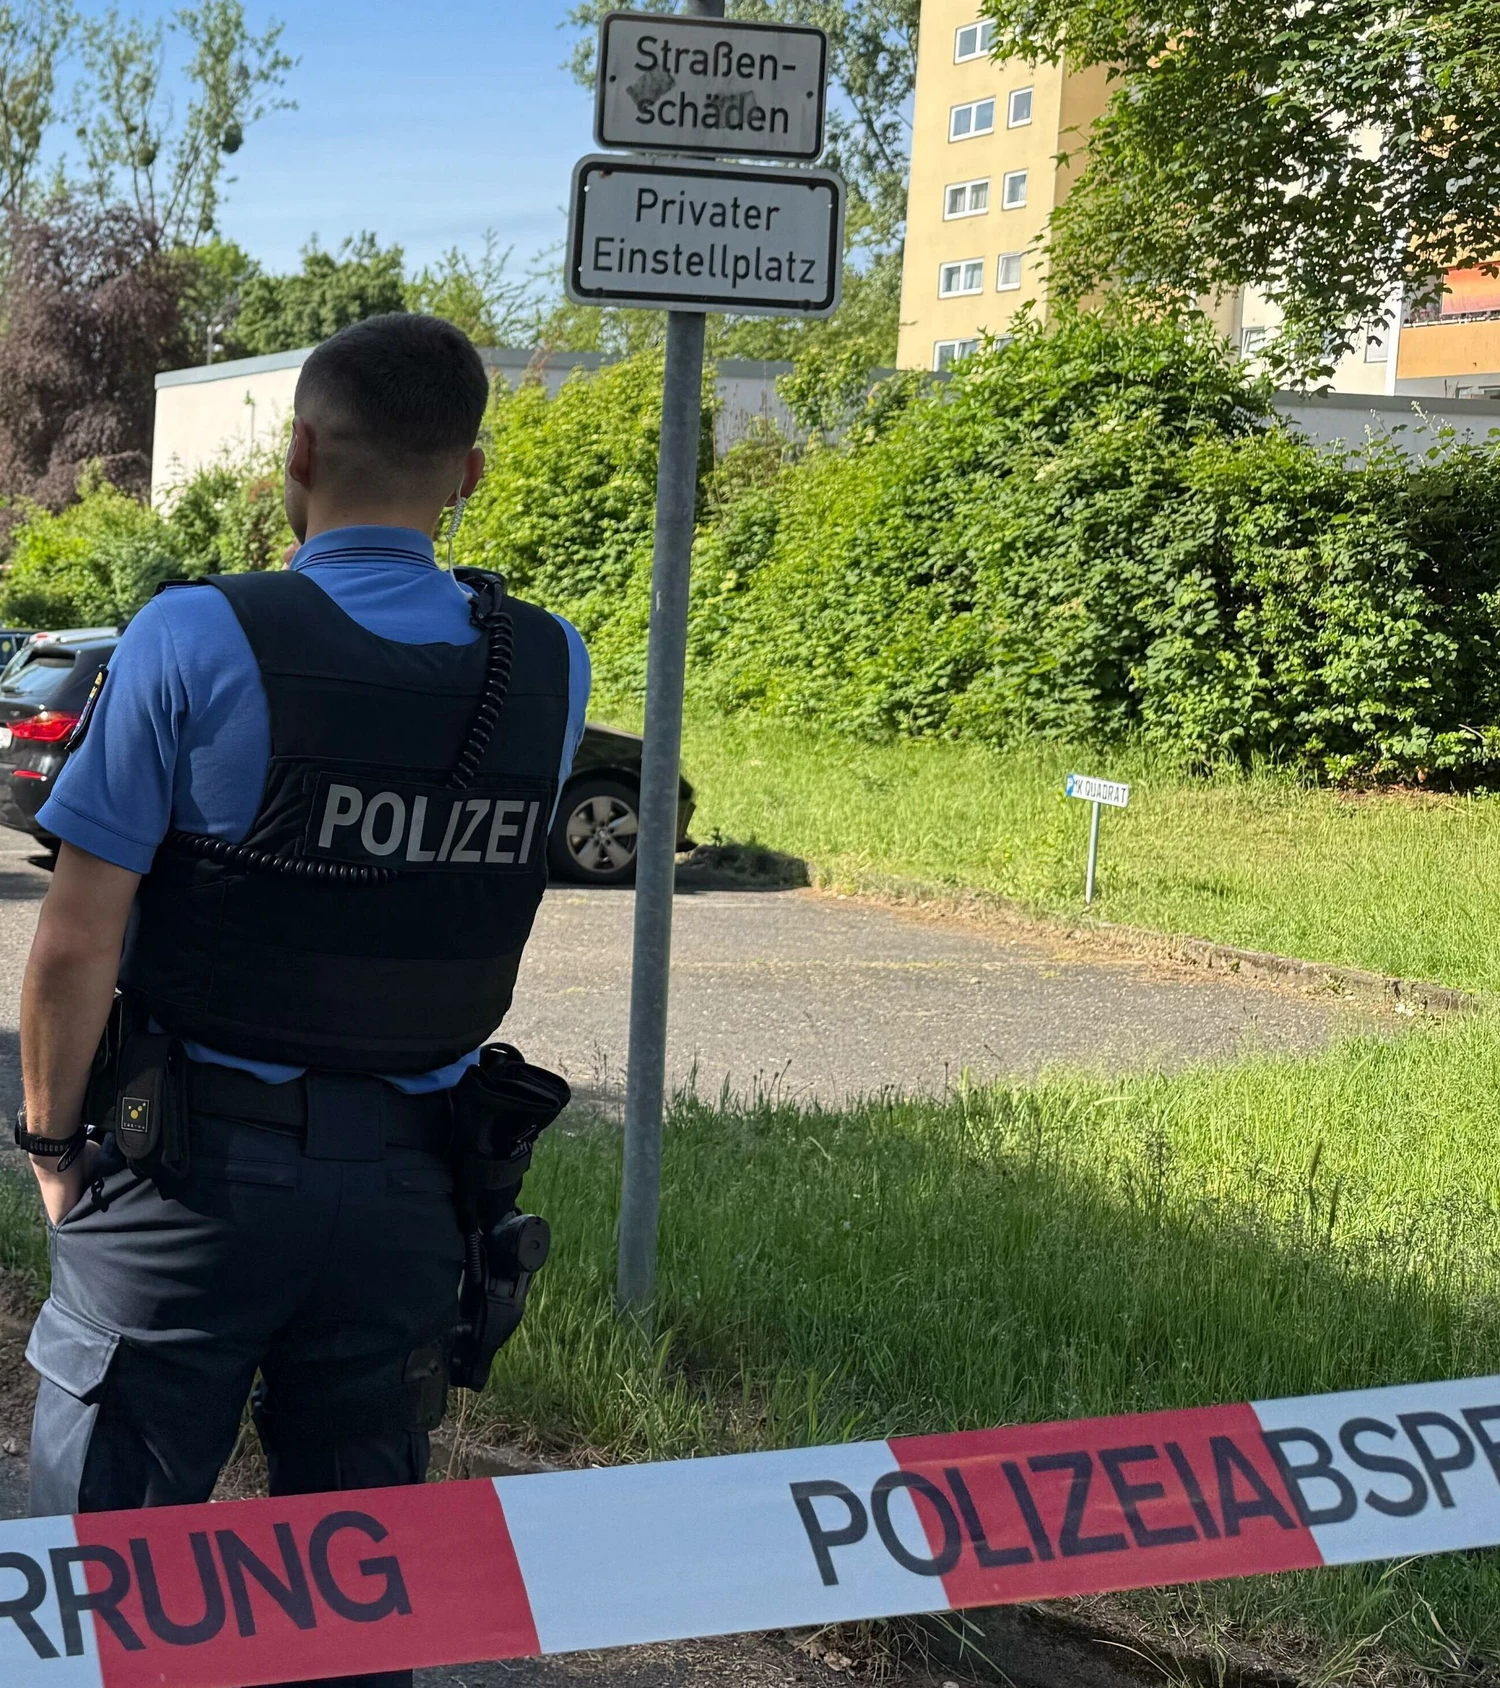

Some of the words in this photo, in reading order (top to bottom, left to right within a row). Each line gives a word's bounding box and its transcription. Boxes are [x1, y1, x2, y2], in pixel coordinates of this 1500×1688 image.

[634, 35, 797, 81] Straßen-
[635, 91, 790, 134] schäden
[635, 187, 781, 231] Privater
[592, 236, 817, 289] Einstellplatz
[317, 783, 541, 864] POLIZEI
